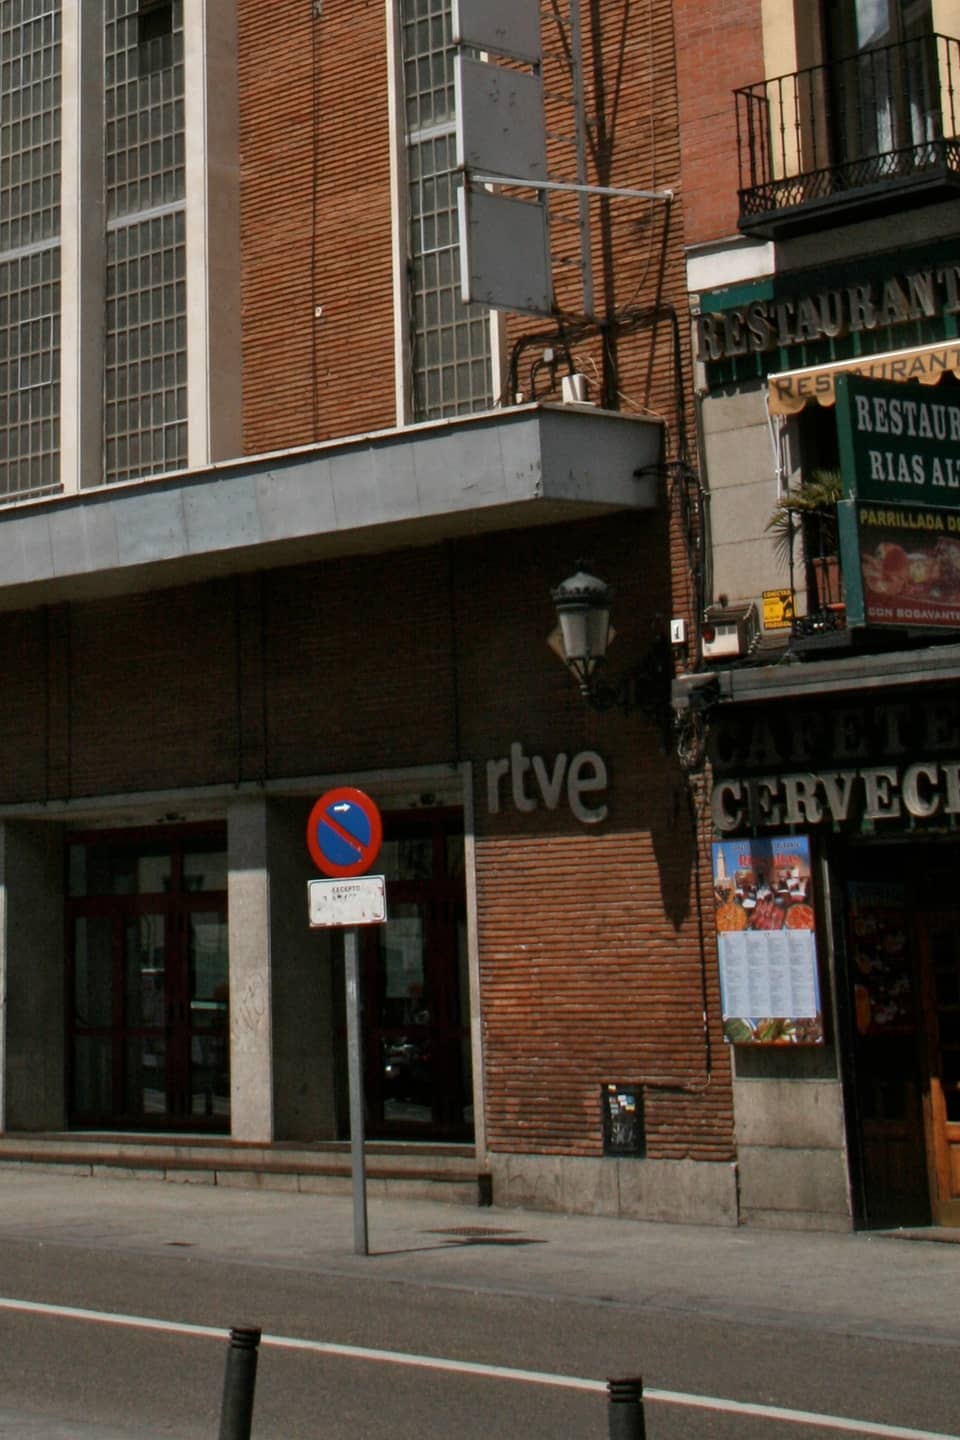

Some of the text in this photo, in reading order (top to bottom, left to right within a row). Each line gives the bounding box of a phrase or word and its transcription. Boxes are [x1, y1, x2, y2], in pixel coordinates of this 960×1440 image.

[868, 450, 925, 485] RIAS
[860, 509, 945, 530] PARRILLADA
[486, 742, 608, 823] rtve
